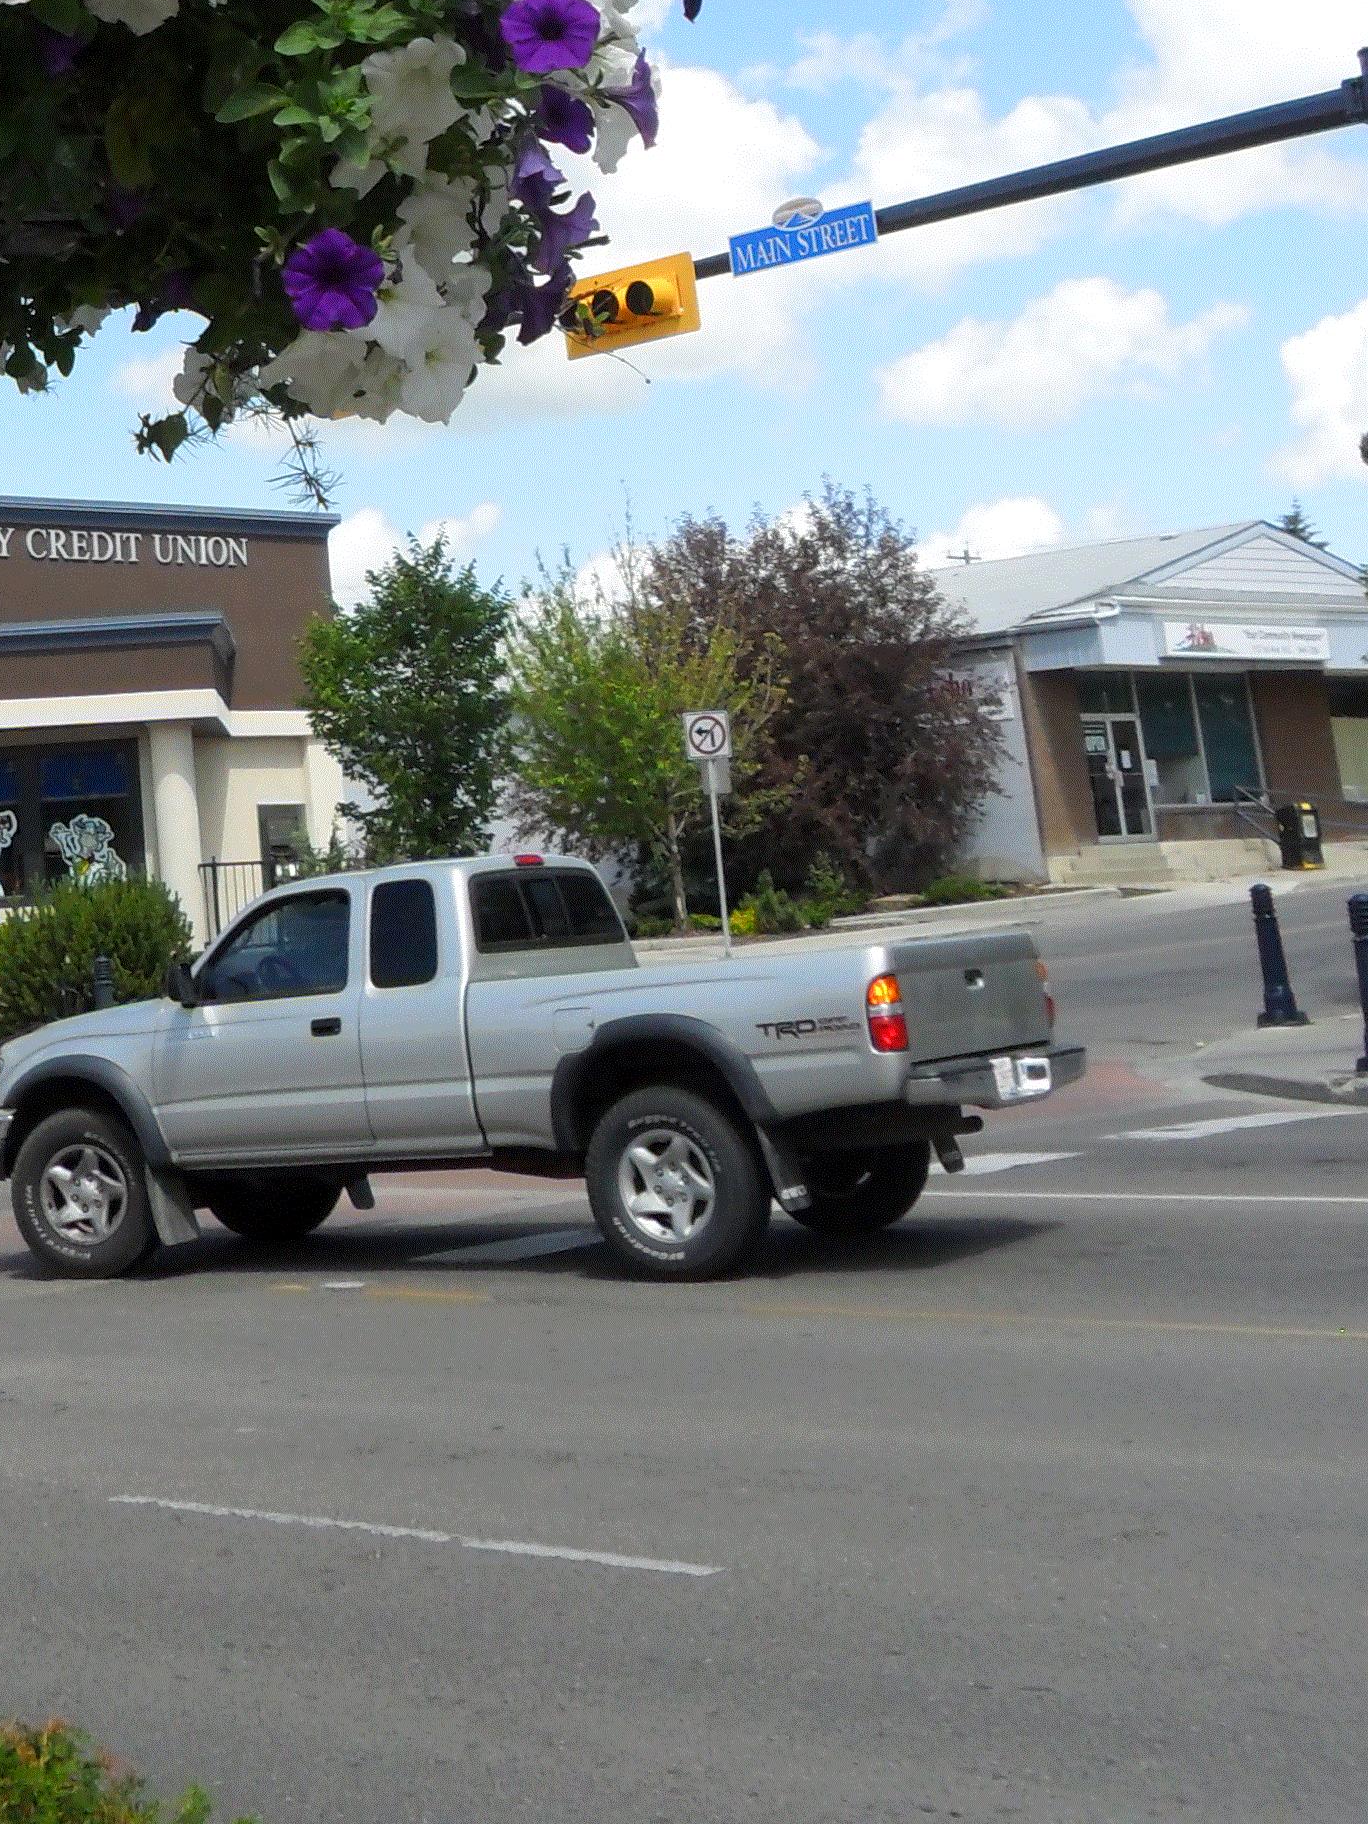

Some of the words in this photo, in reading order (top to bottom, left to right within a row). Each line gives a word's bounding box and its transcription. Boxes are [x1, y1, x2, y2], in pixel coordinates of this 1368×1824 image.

[735, 234, 792, 272] MAIN
[796, 213, 870, 256] STREET
[25, 528, 142, 563] CREDIT
[151, 533, 249, 566] UNION
[755, 1019, 816, 1040] TRD
